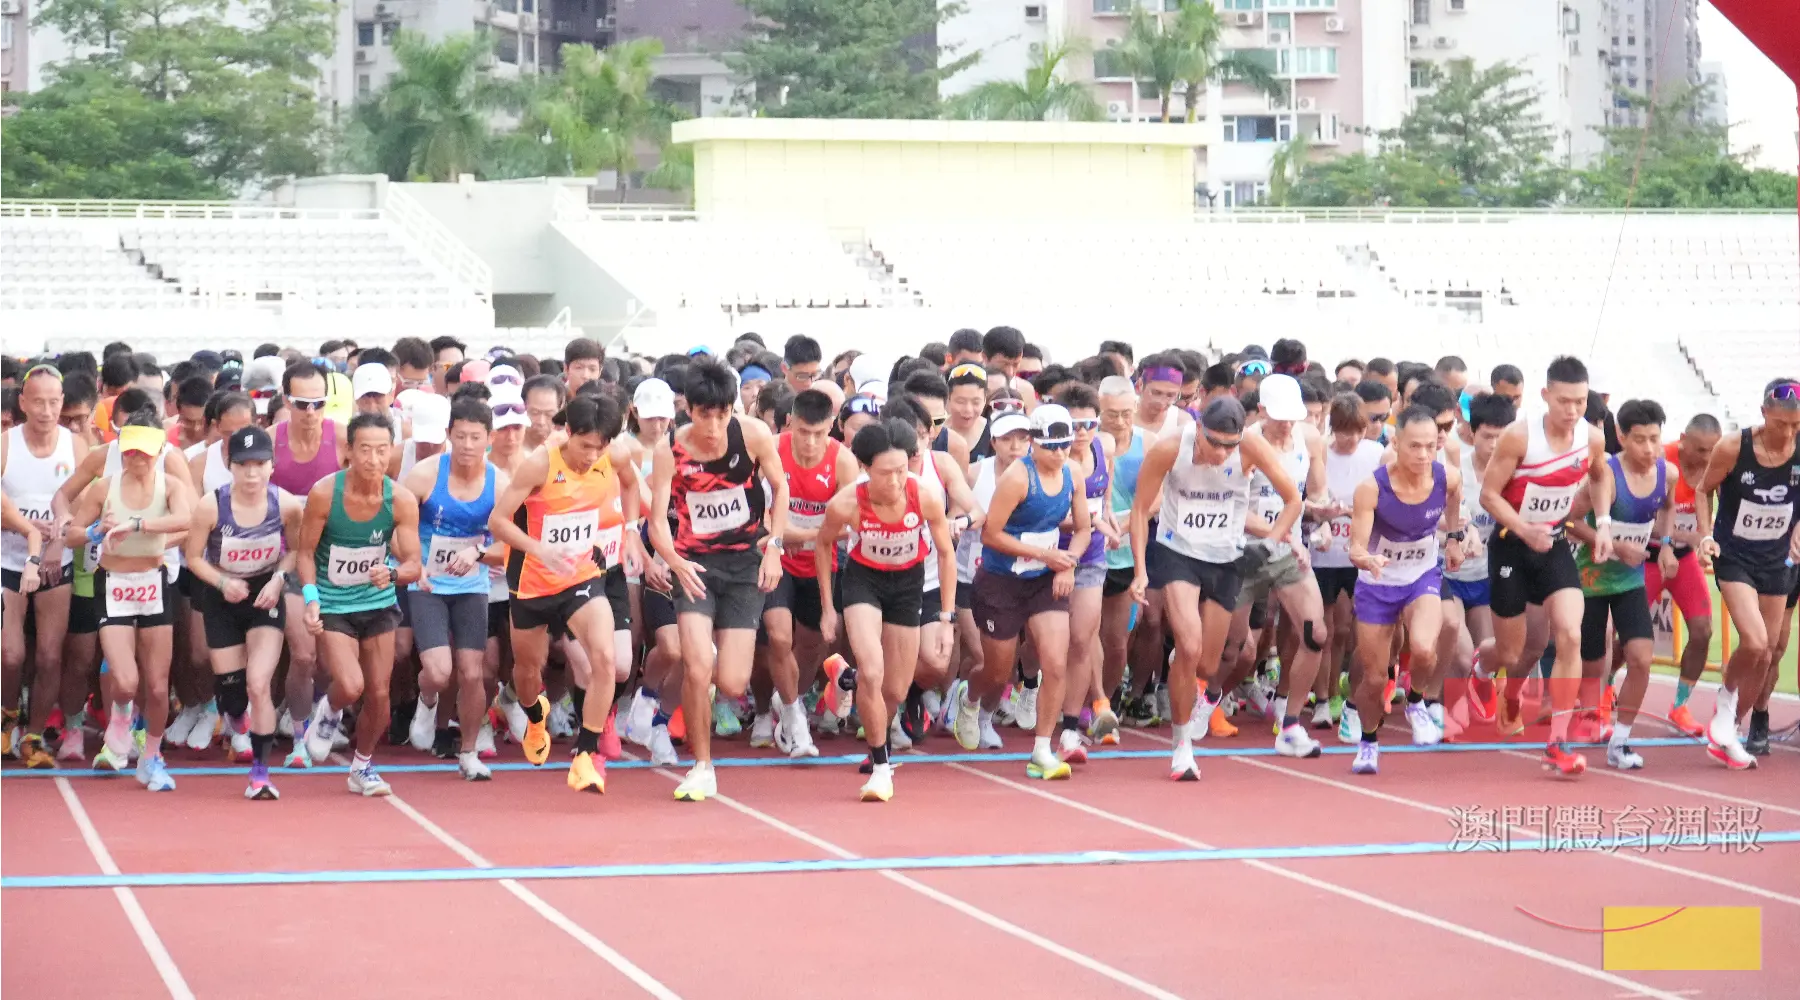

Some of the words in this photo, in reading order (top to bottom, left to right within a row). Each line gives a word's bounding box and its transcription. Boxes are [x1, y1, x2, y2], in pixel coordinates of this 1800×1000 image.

[695, 498, 742, 519] 2004
[1528, 496, 1570, 512] 3013
[1183, 512, 1228, 529] 4072
[1742, 514, 1785, 529] 6125
[548, 524, 592, 543] 3011
[227, 546, 275, 562] 9207
[112, 584, 157, 603] 9222
